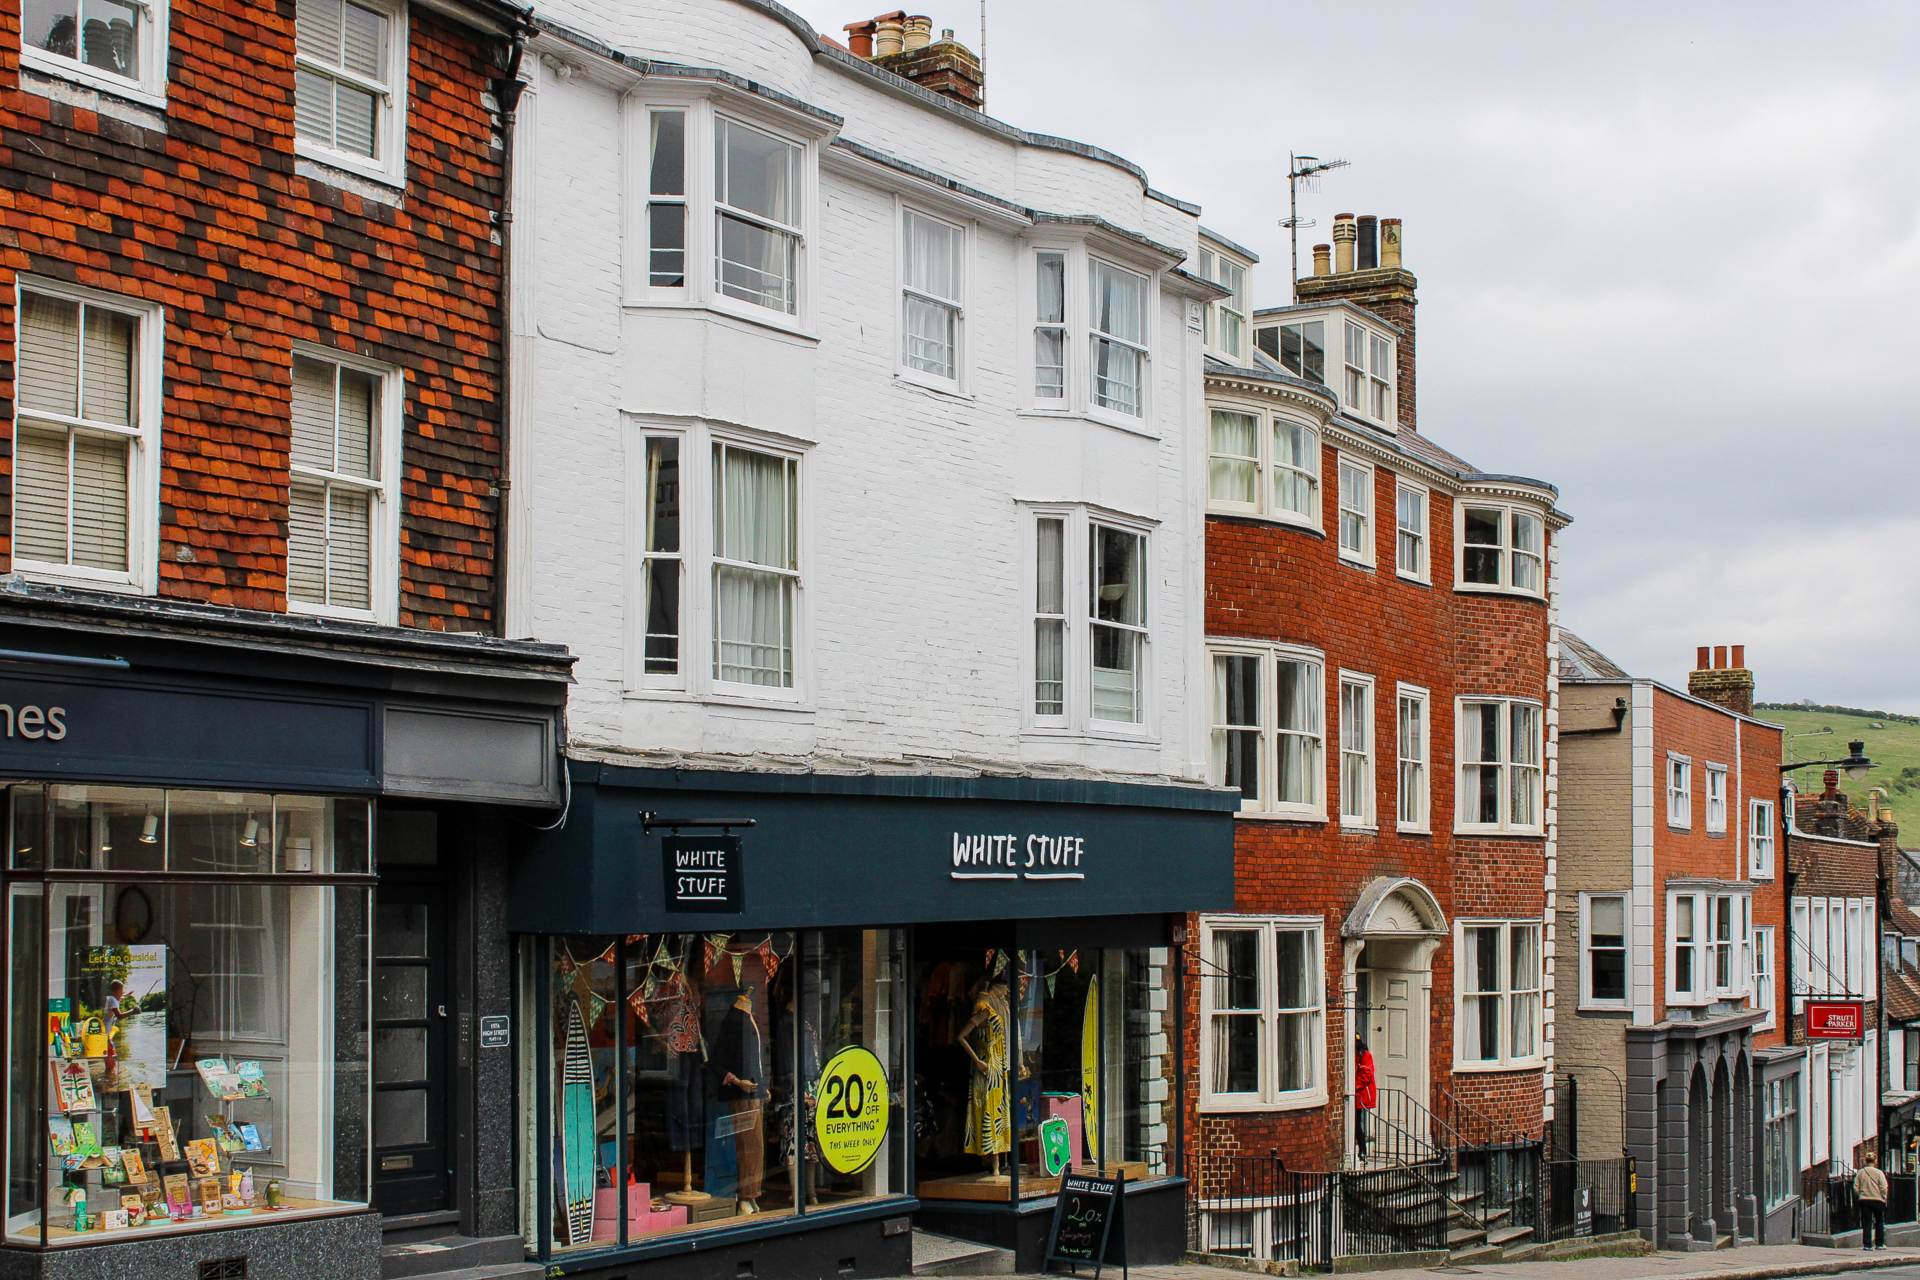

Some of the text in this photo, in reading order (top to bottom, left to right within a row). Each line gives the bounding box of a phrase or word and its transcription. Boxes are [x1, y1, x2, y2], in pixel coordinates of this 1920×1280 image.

[952, 832, 1084, 868] WHITE STUFF
[676, 849, 726, 867] WHITE
[677, 877, 726, 894] STUFF
[110, 955, 122, 966] go
[865, 1105, 880, 1116] OFF
[829, 1138, 877, 1150] THIS WEEK ONLY
[1066, 1180, 1114, 1192] WHITE STUFF
